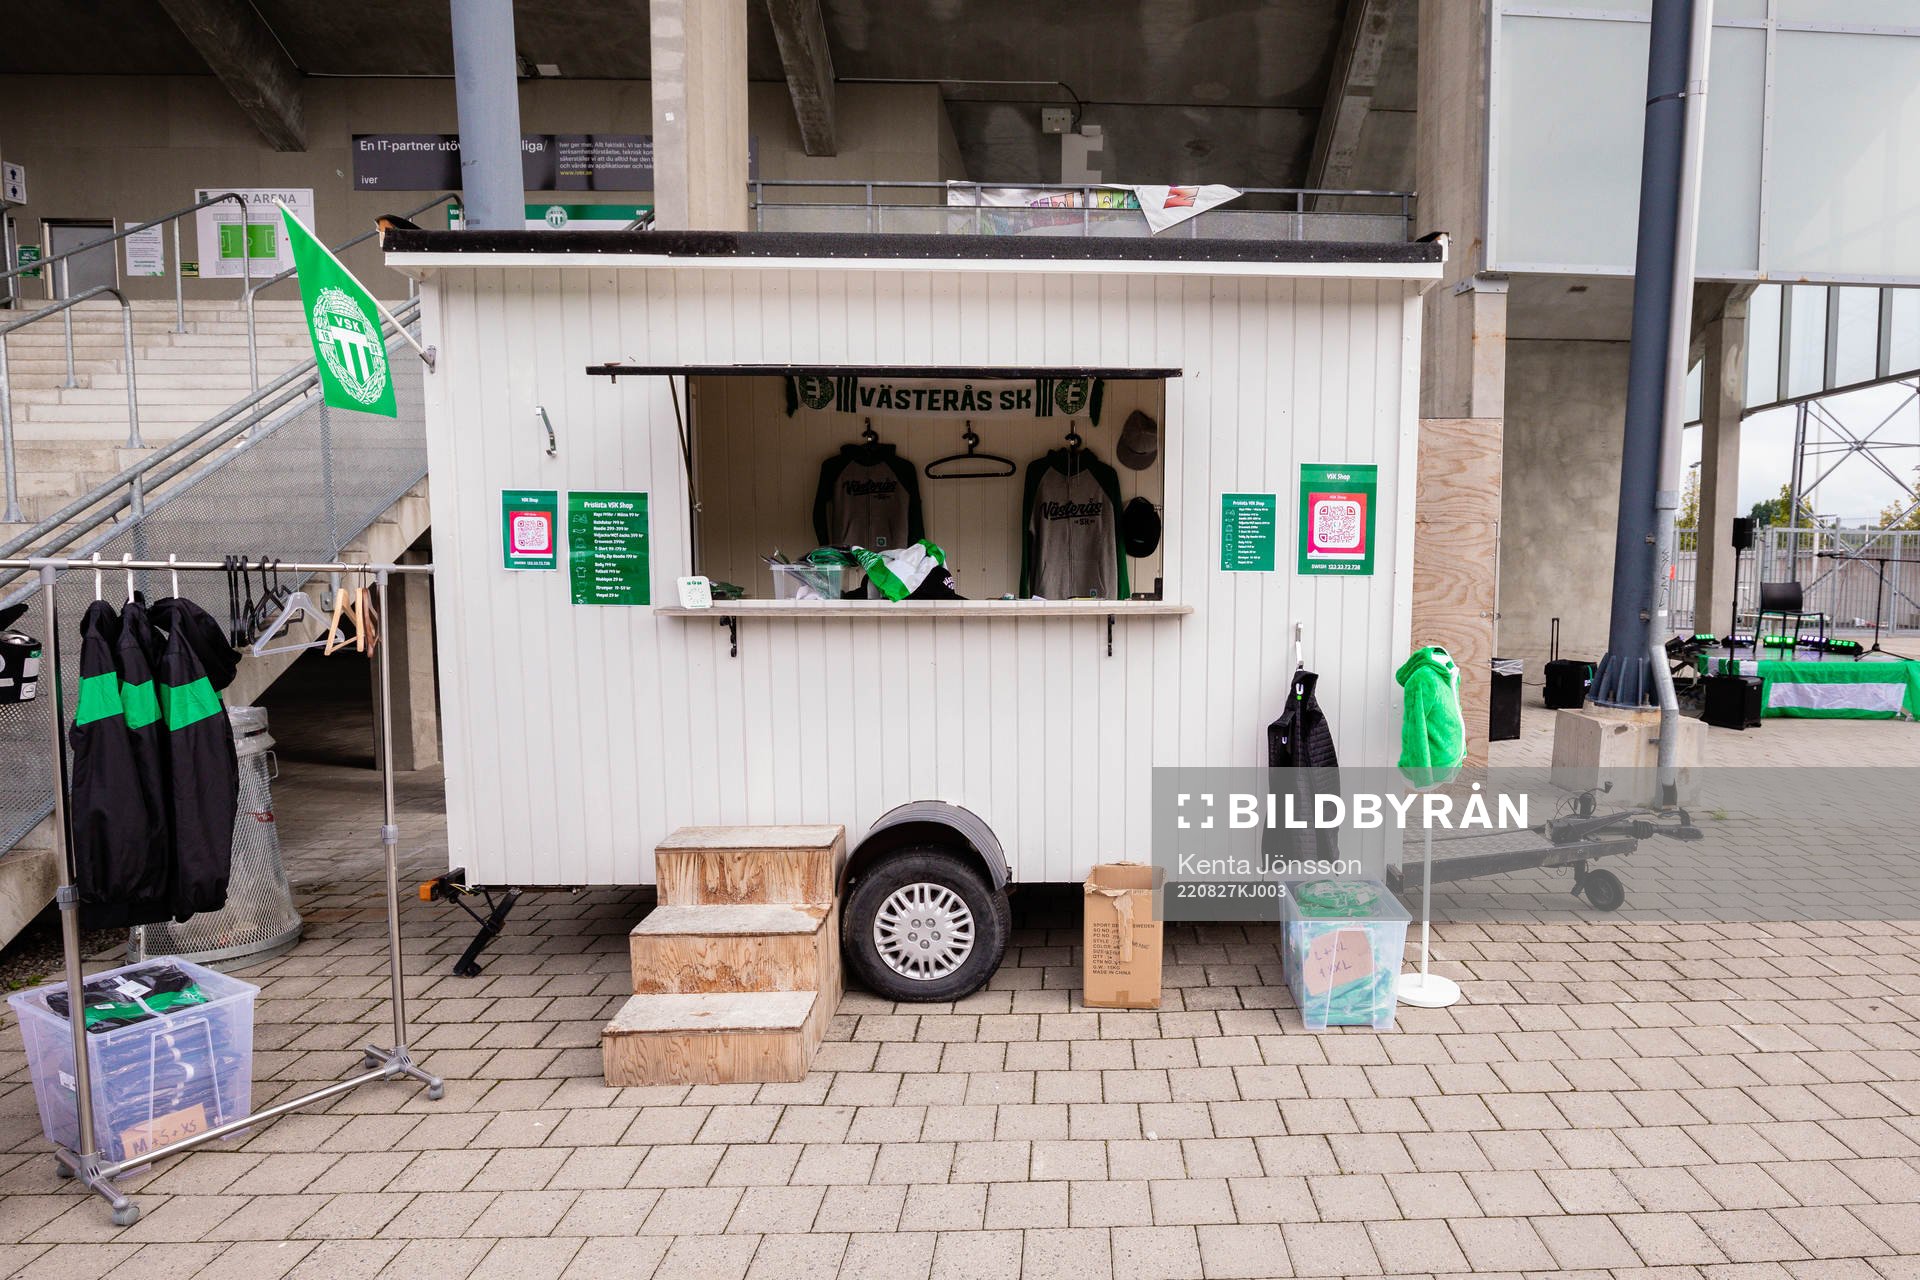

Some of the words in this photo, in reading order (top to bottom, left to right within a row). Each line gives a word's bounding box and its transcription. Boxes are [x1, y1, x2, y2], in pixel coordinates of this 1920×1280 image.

[360, 140, 375, 151] En
[377, 140, 435, 153] IT-partner
[361, 175, 378, 185] iver
[333, 315, 360, 333] VSK
[859, 384, 993, 412] VÄSTERÅS
[1000, 389, 1032, 410] SK
[1337, 473, 1351, 482] Shop
[607, 501, 619, 509] VSK
[619, 501, 634, 510] Shop
